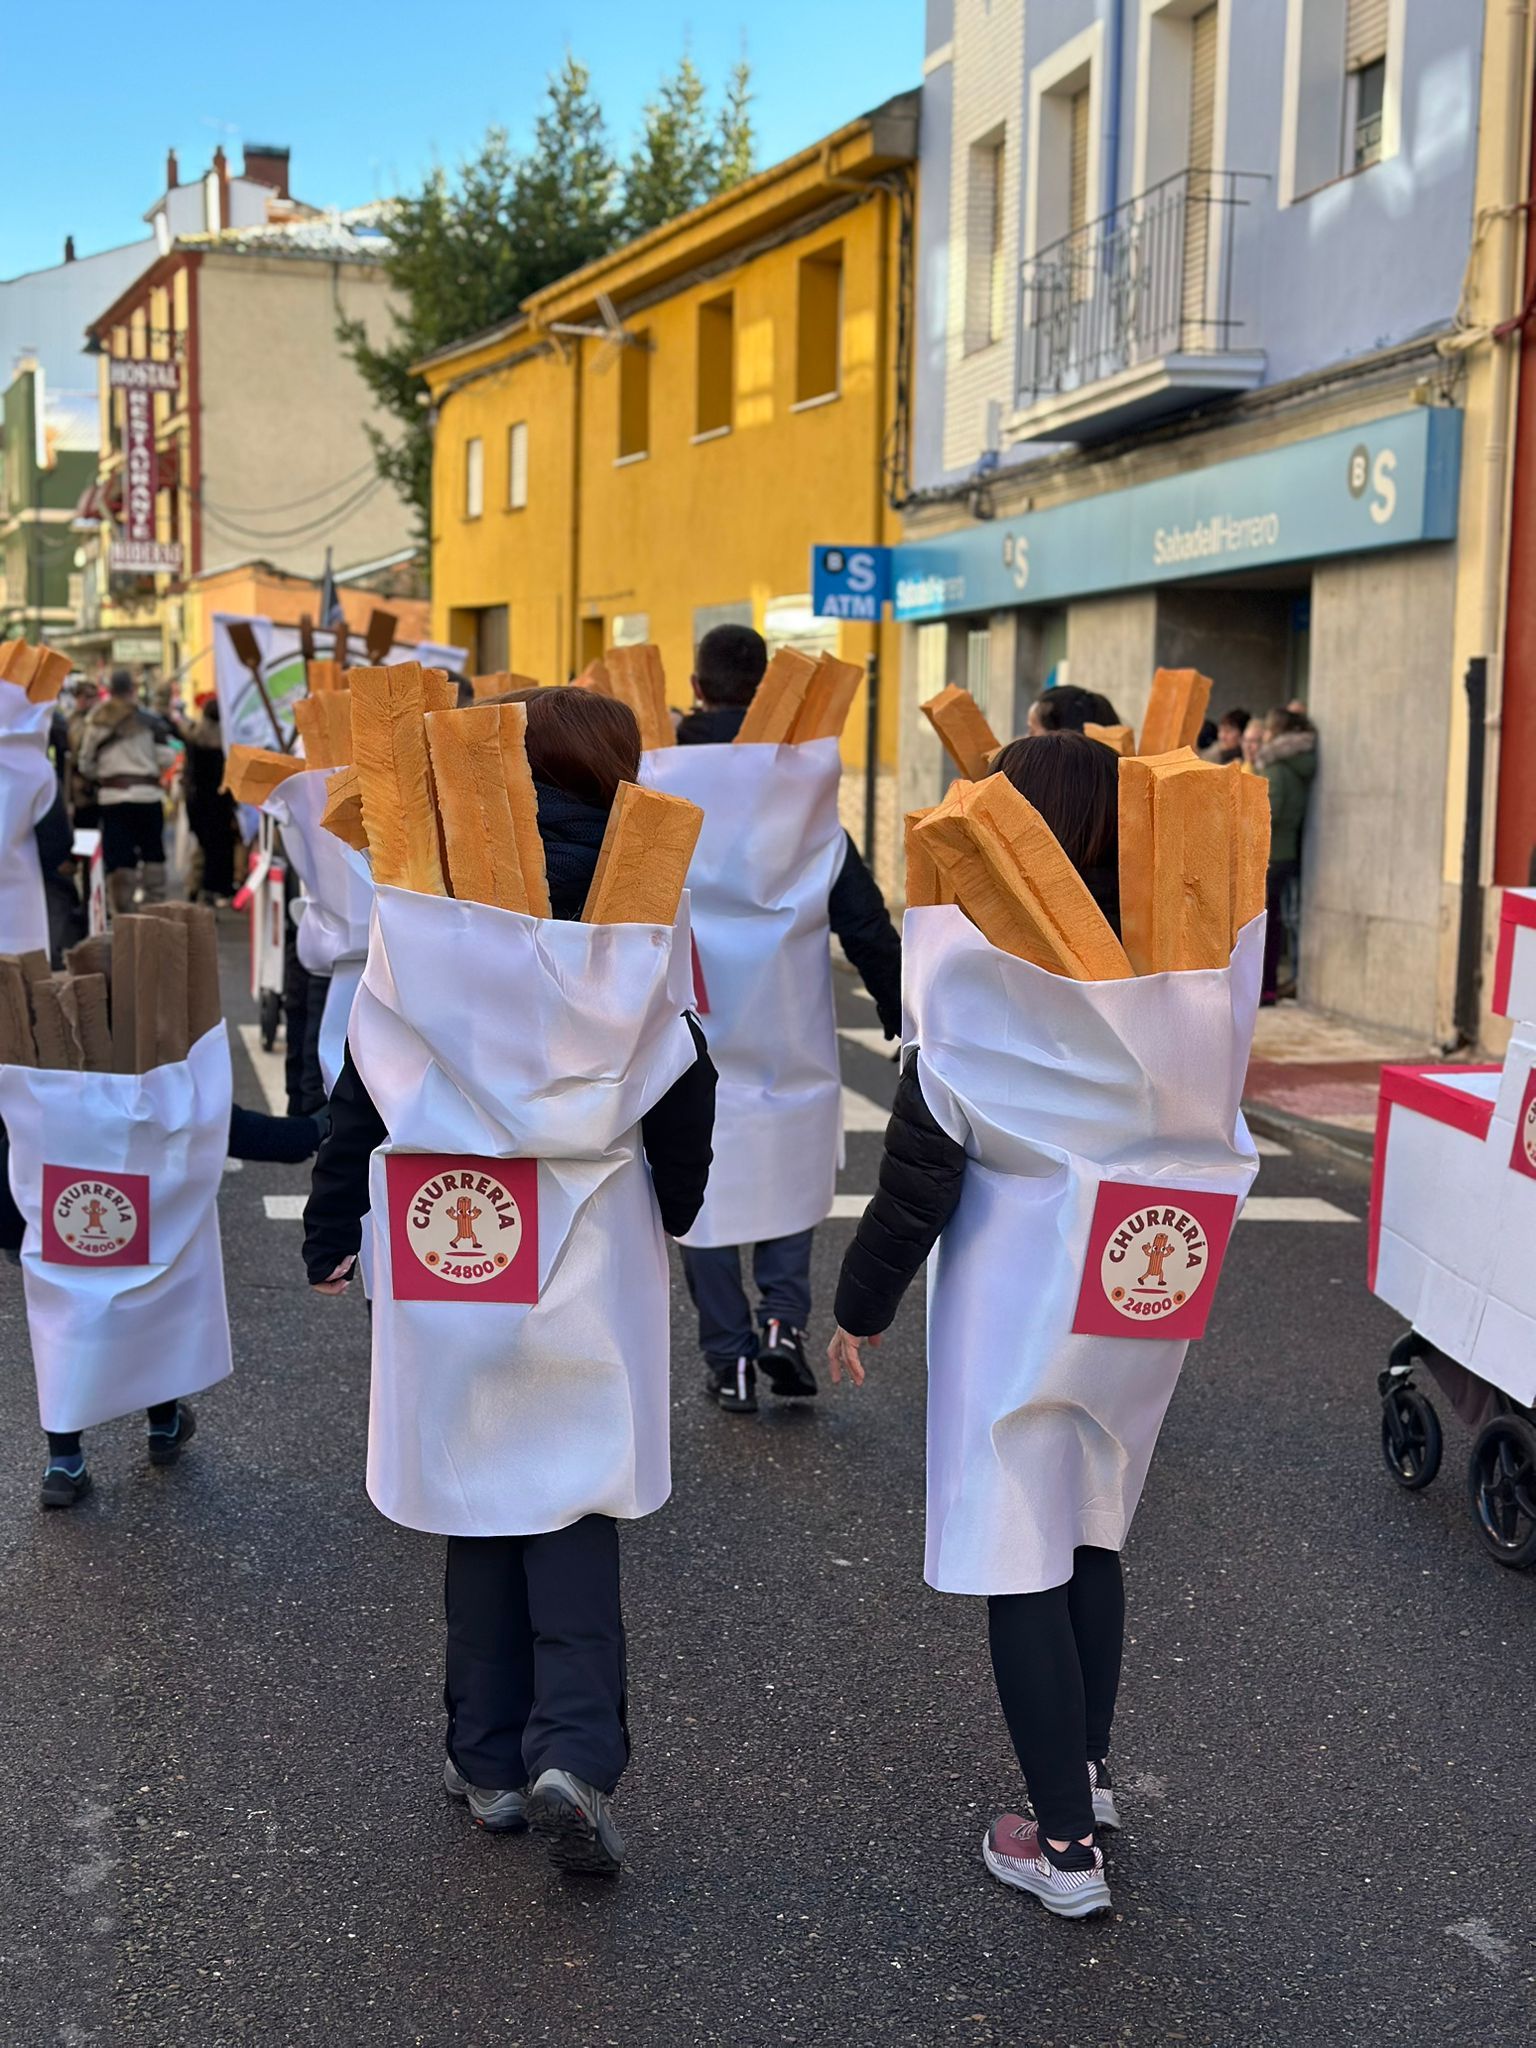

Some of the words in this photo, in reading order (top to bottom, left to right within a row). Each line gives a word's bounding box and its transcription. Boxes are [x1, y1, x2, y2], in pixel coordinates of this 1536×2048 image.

[110, 361, 178, 389] HOSTAL
[128, 390, 152, 539] RESTAURANTE
[822, 594, 875, 618] ATM
[412, 1172, 515, 1230] CHURRERÍA
[75, 1240, 116, 1253] 24800
[1109, 1208, 1206, 1269] CHURRERÍA
[440, 1260, 495, 1279] 24800
[1122, 1297, 1172, 1315] 24800
